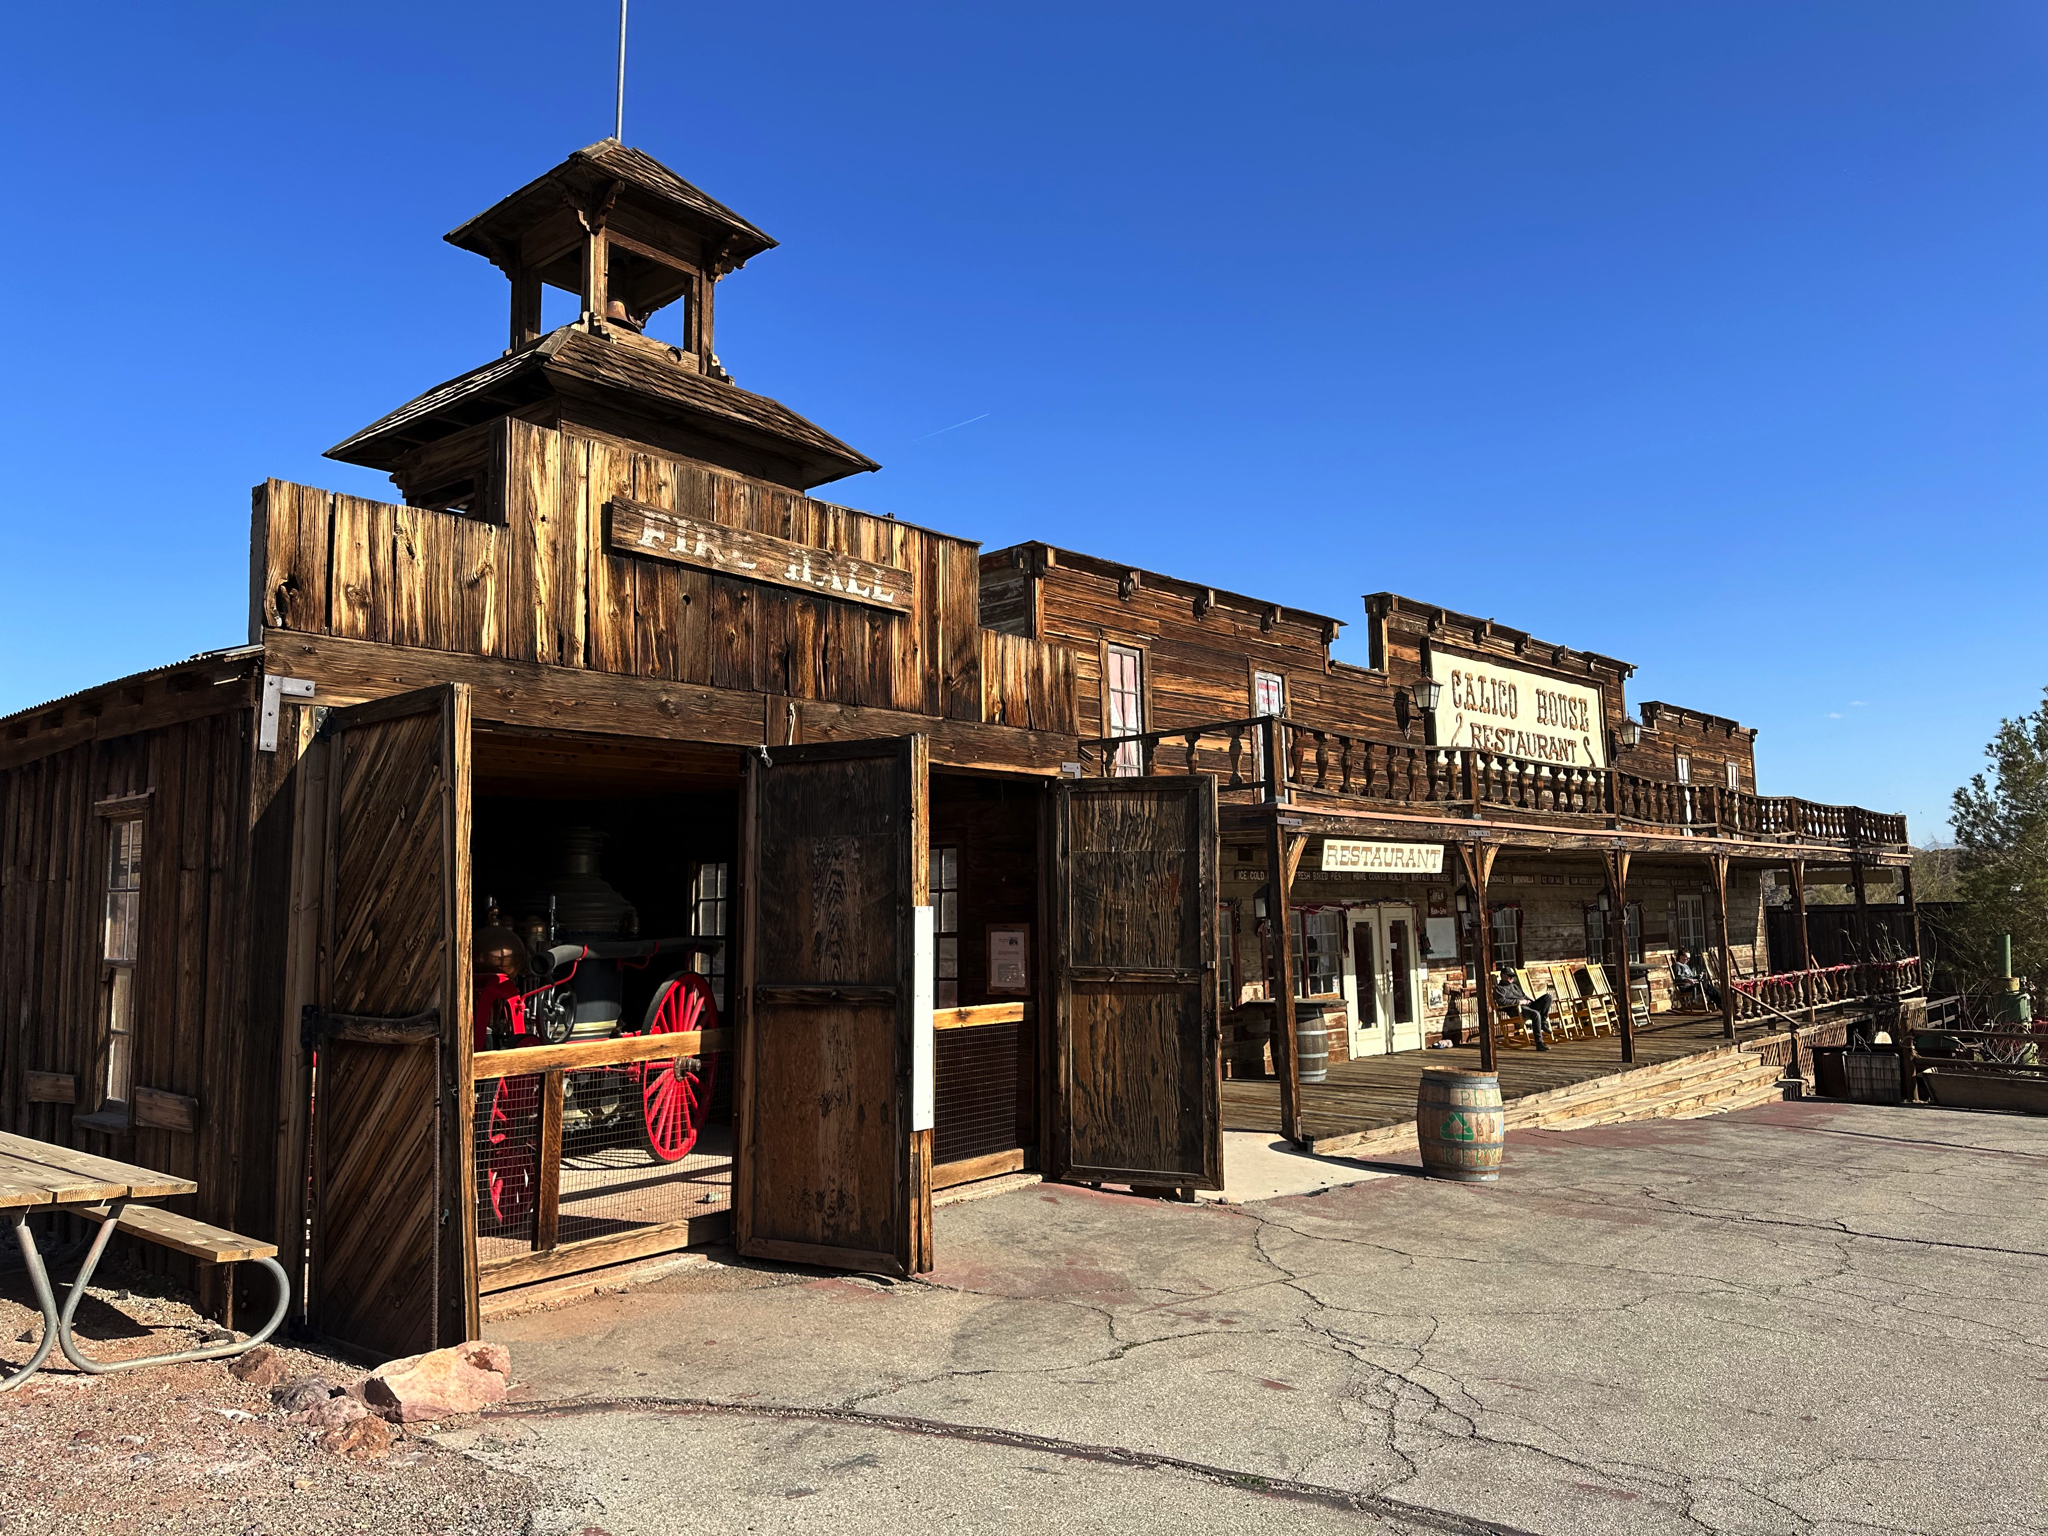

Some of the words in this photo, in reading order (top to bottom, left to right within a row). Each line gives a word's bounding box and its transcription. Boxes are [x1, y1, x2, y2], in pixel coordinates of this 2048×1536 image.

[1451, 669, 1518, 719] CALICO
[1535, 688, 1590, 733] HOUSE
[1469, 722, 1577, 764] RESTAURANT
[1326, 844, 1441, 869] RESTAURANT
[1250, 871, 1265, 881] COLD
